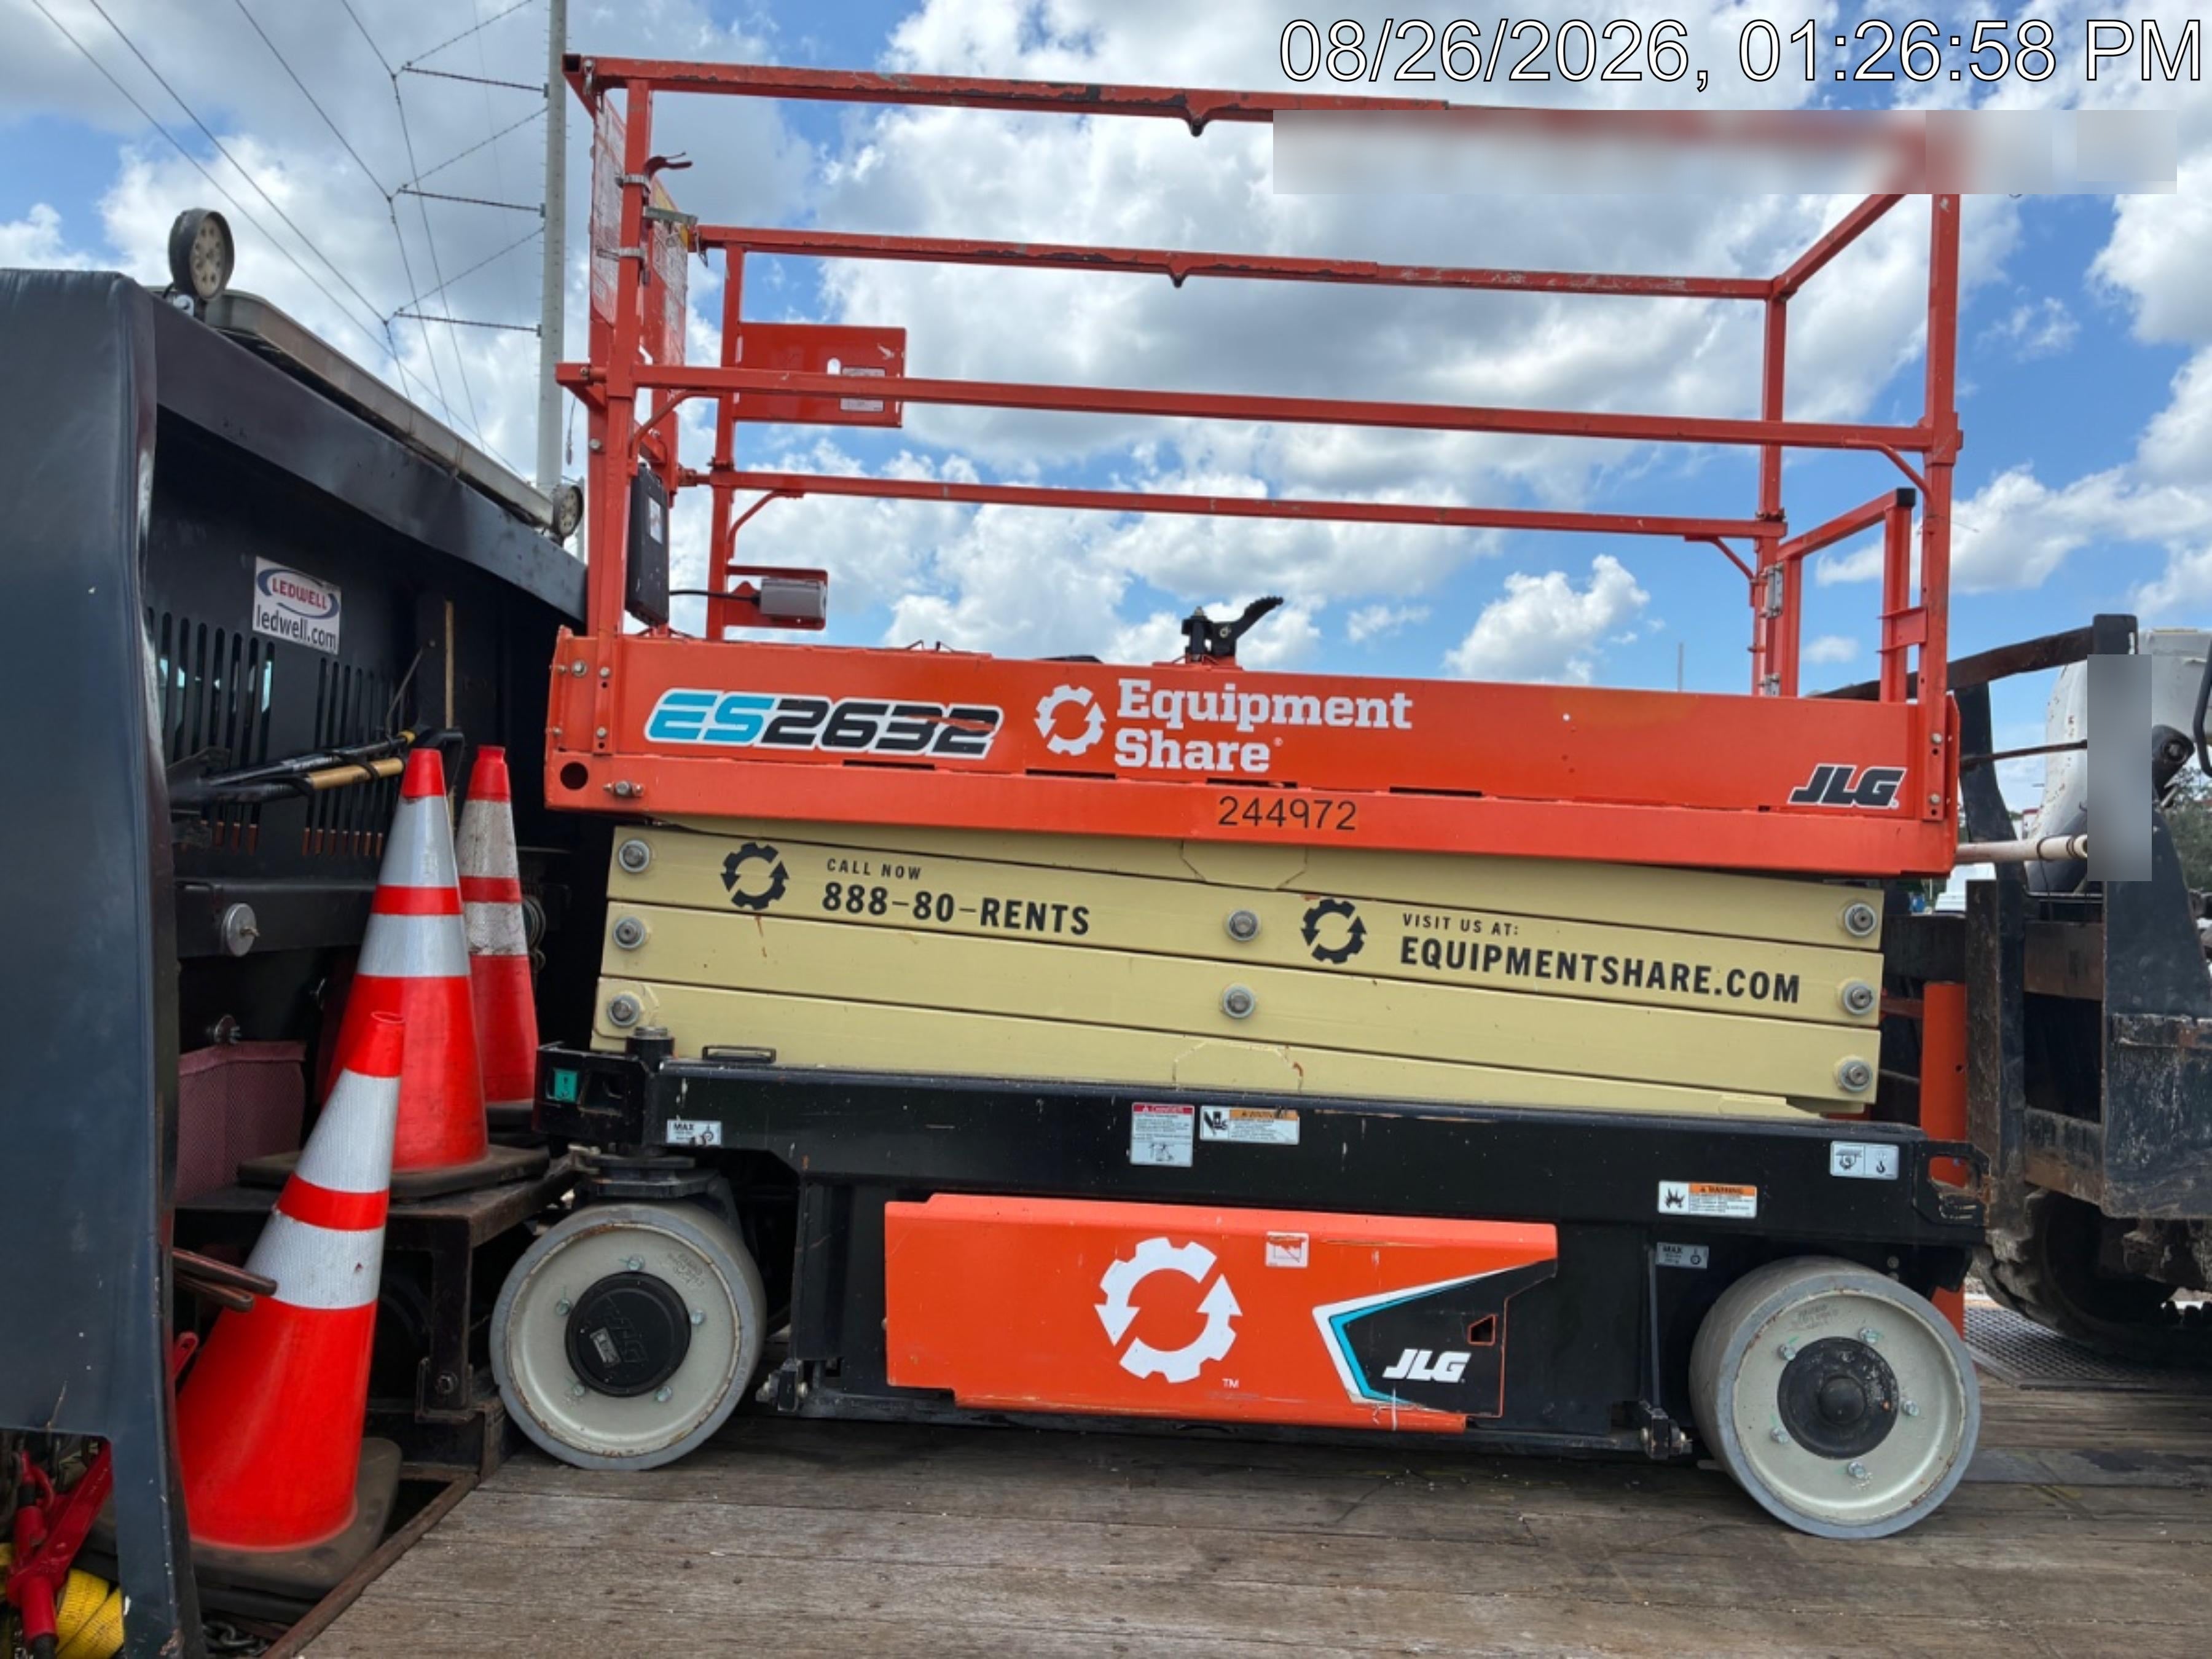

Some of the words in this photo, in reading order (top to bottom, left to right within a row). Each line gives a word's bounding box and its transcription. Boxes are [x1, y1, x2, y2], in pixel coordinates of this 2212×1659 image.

[272, 576, 327, 610] LEDWELL
[256, 604, 336, 650] ledwell.com
[645, 689, 1002, 758] ES2632
[1116, 678, 1413, 732] Equipment
[1114, 728, 1271, 773] Share
[1787, 763, 1907, 809] JLG
[1218, 796, 1357, 830] 244972
[827, 858, 871, 876] CALL
[881, 864, 921, 880] NOW
[822, 882, 1090, 936] 888-80-RENTS
[1403, 913, 1451, 930] VISIT
[1460, 919, 1483, 933] US
[1491, 922, 1519, 937] AT:
[1400, 936, 1801, 1003] EQUIPMENTSHARE.COM
[1382, 1348, 1472, 1383] JLG
